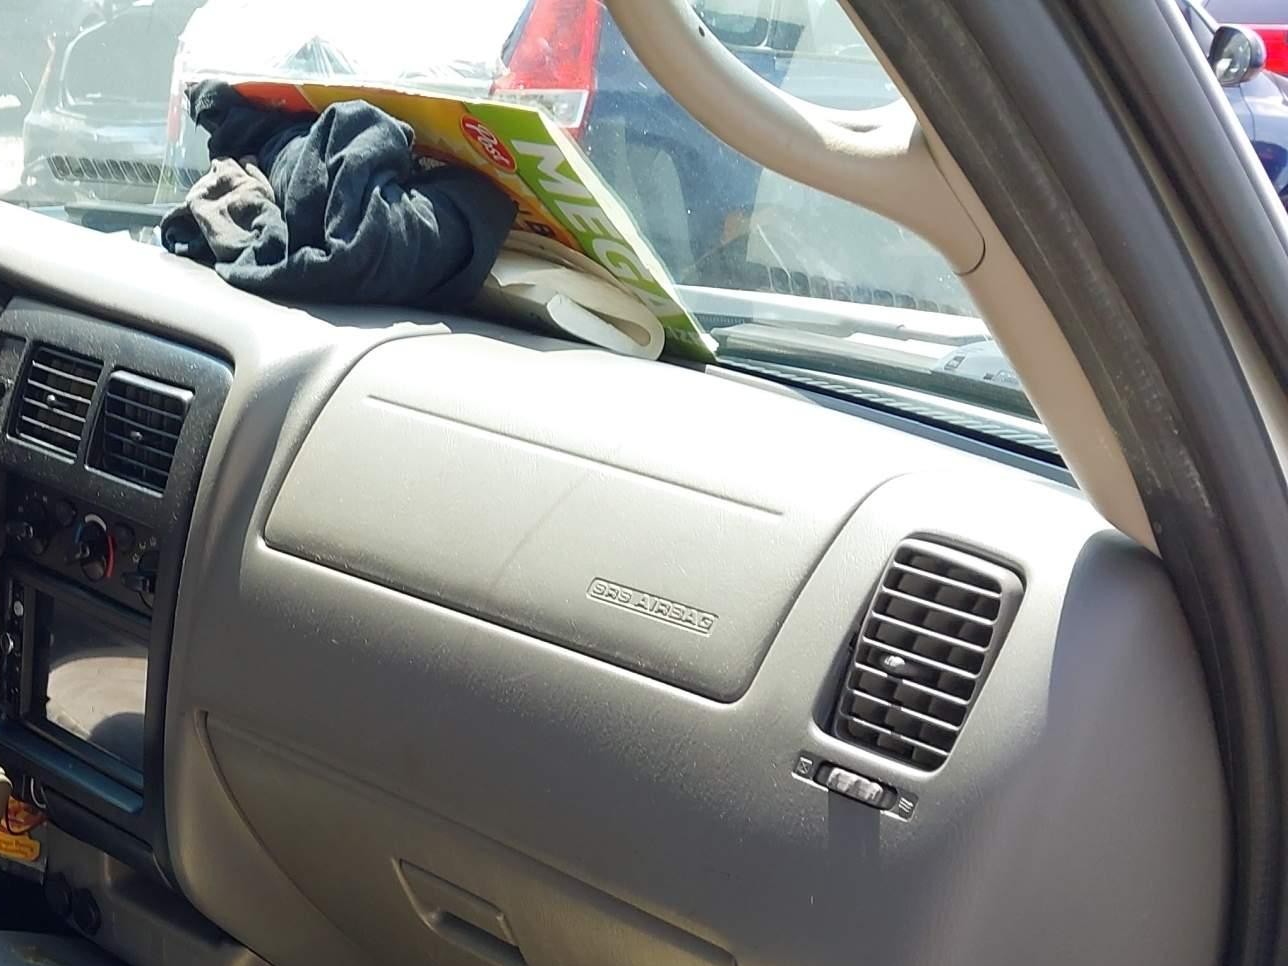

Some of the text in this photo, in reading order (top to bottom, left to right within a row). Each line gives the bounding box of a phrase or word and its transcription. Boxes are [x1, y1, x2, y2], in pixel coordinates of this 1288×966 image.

[465, 123, 511, 167] Post
[511, 139, 685, 318] MEGA
[592, 582, 714, 630] SRS AIRBAG
